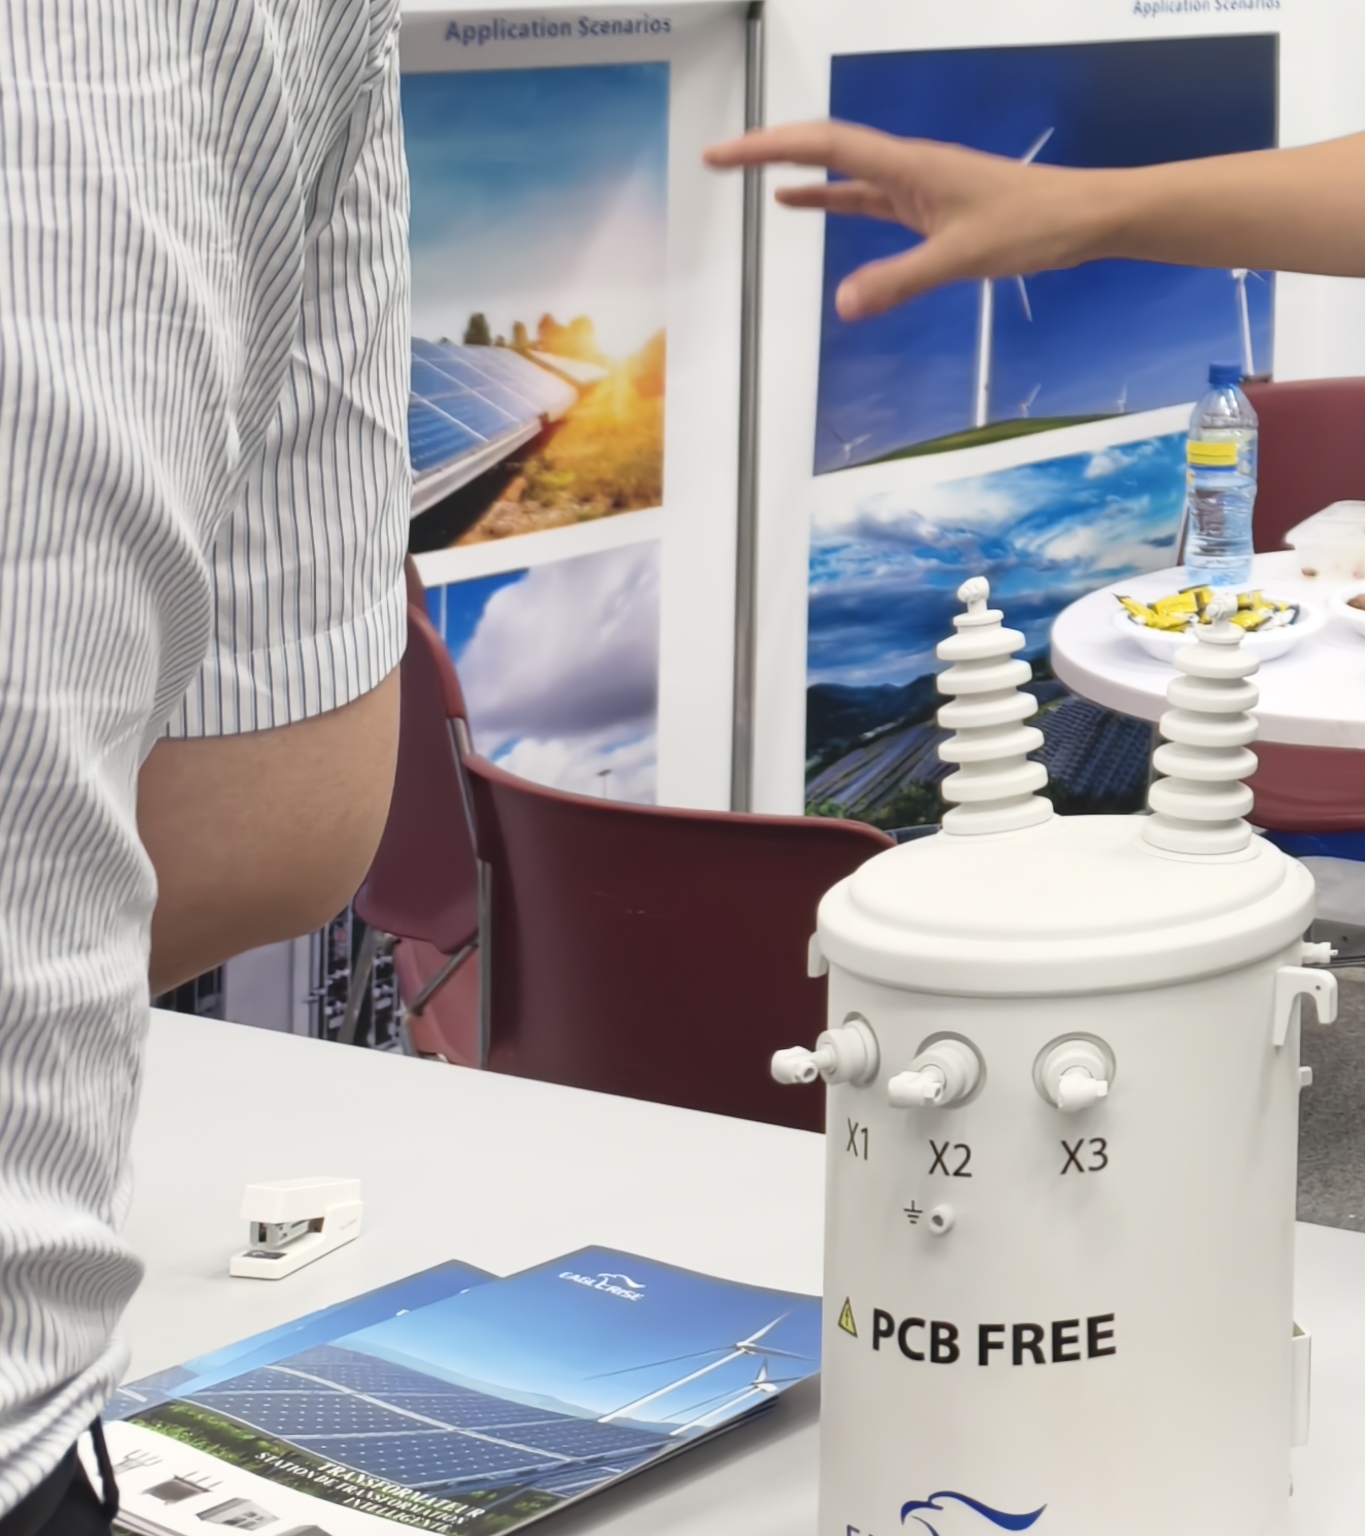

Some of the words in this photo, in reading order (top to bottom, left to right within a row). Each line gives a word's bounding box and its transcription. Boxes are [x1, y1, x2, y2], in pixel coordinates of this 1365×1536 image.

[445, 18, 573, 46] Application
[579, 14, 671, 38] Scenarios
[846, 1116, 871, 1161] X1
[1059, 1136, 1110, 1175] X3
[927, 1139, 974, 1178] X2
[871, 1307, 961, 1365] PCB
[976, 1311, 1118, 1367] FREE
[254, 1450, 319, 1481] STATION
[318, 1461, 486, 1519] TRANSFORMATEUR
